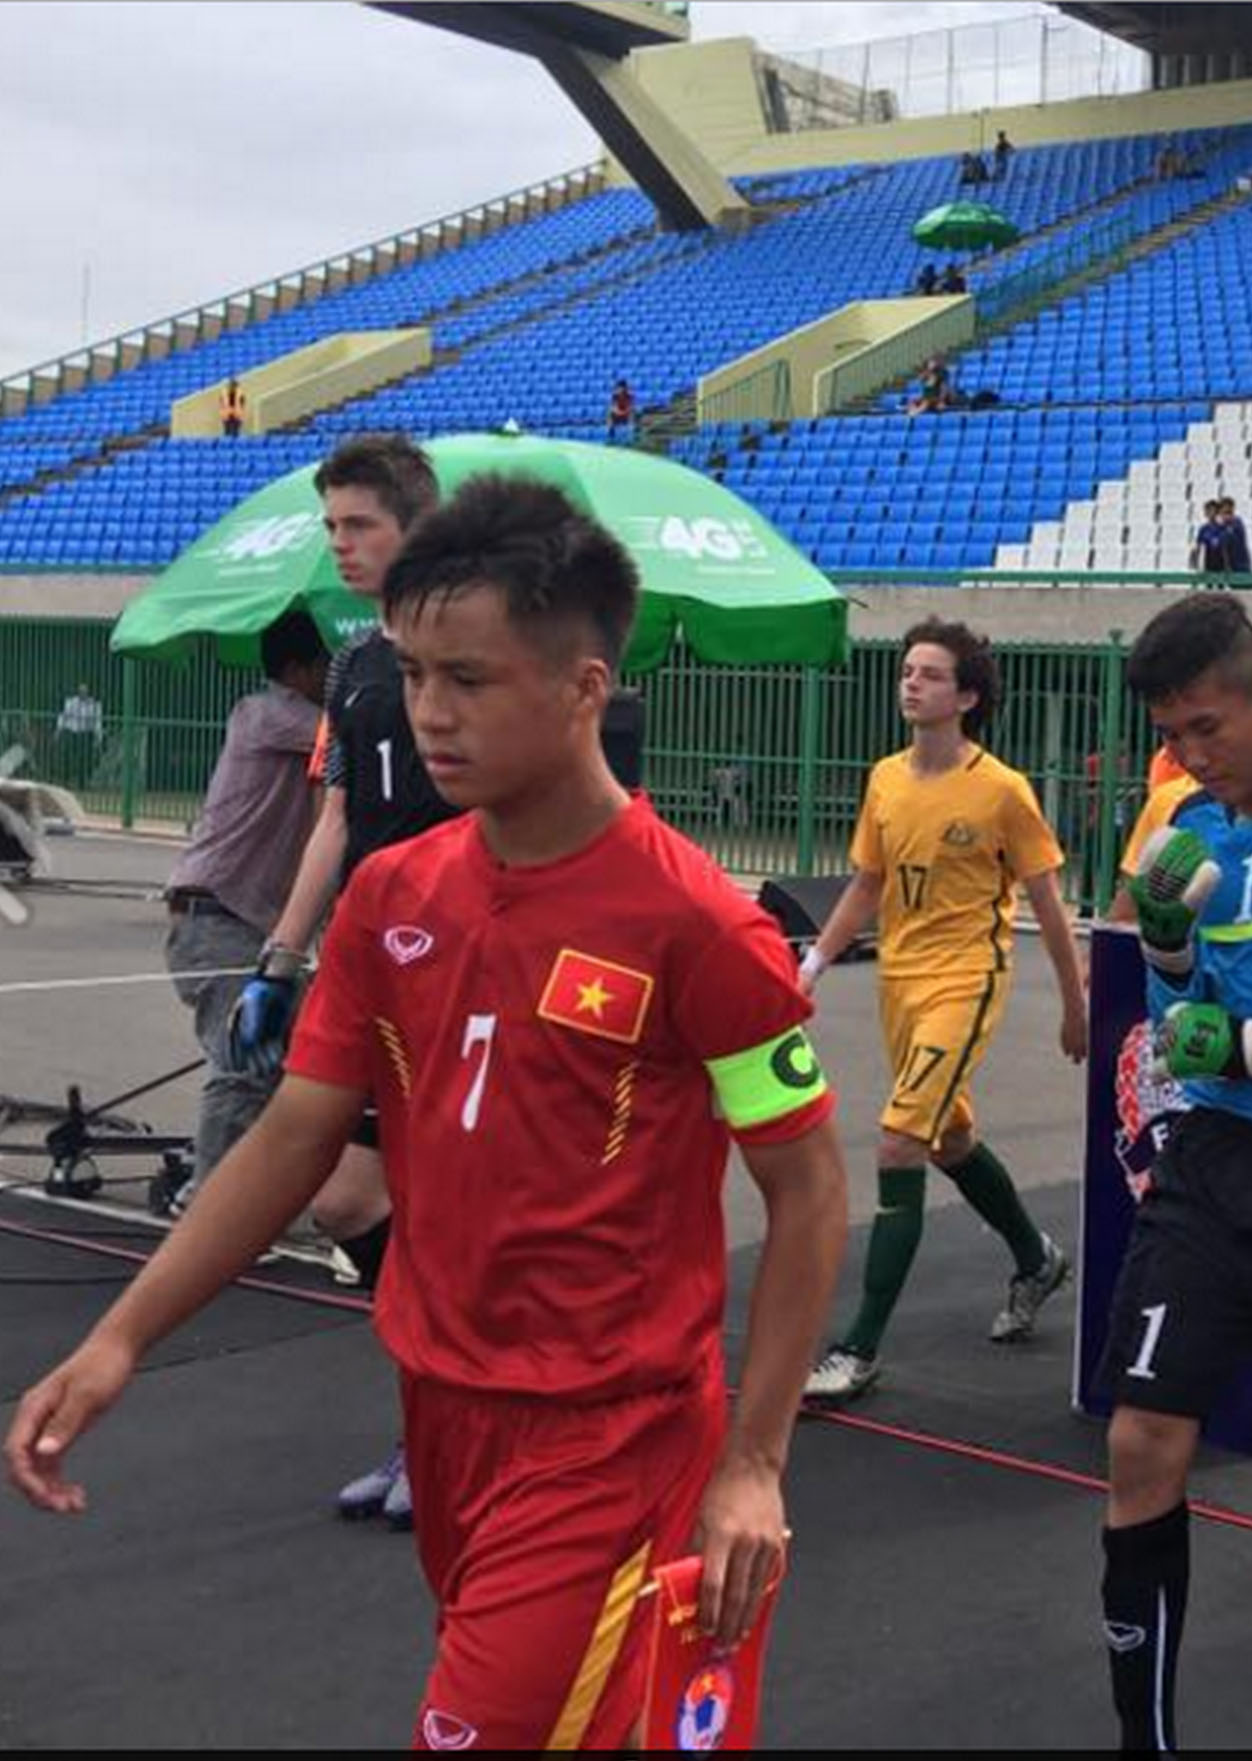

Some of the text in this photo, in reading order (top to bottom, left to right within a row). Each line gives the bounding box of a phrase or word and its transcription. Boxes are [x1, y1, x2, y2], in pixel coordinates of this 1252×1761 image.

[660, 515, 743, 561] 4G
[376, 739, 392, 800] 1
[899, 864, 927, 910] 17
[461, 1014, 496, 1131] 7
[770, 1031, 820, 1088] C
[901, 1046, 946, 1091] 17
[1126, 1303, 1167, 1379] 1
